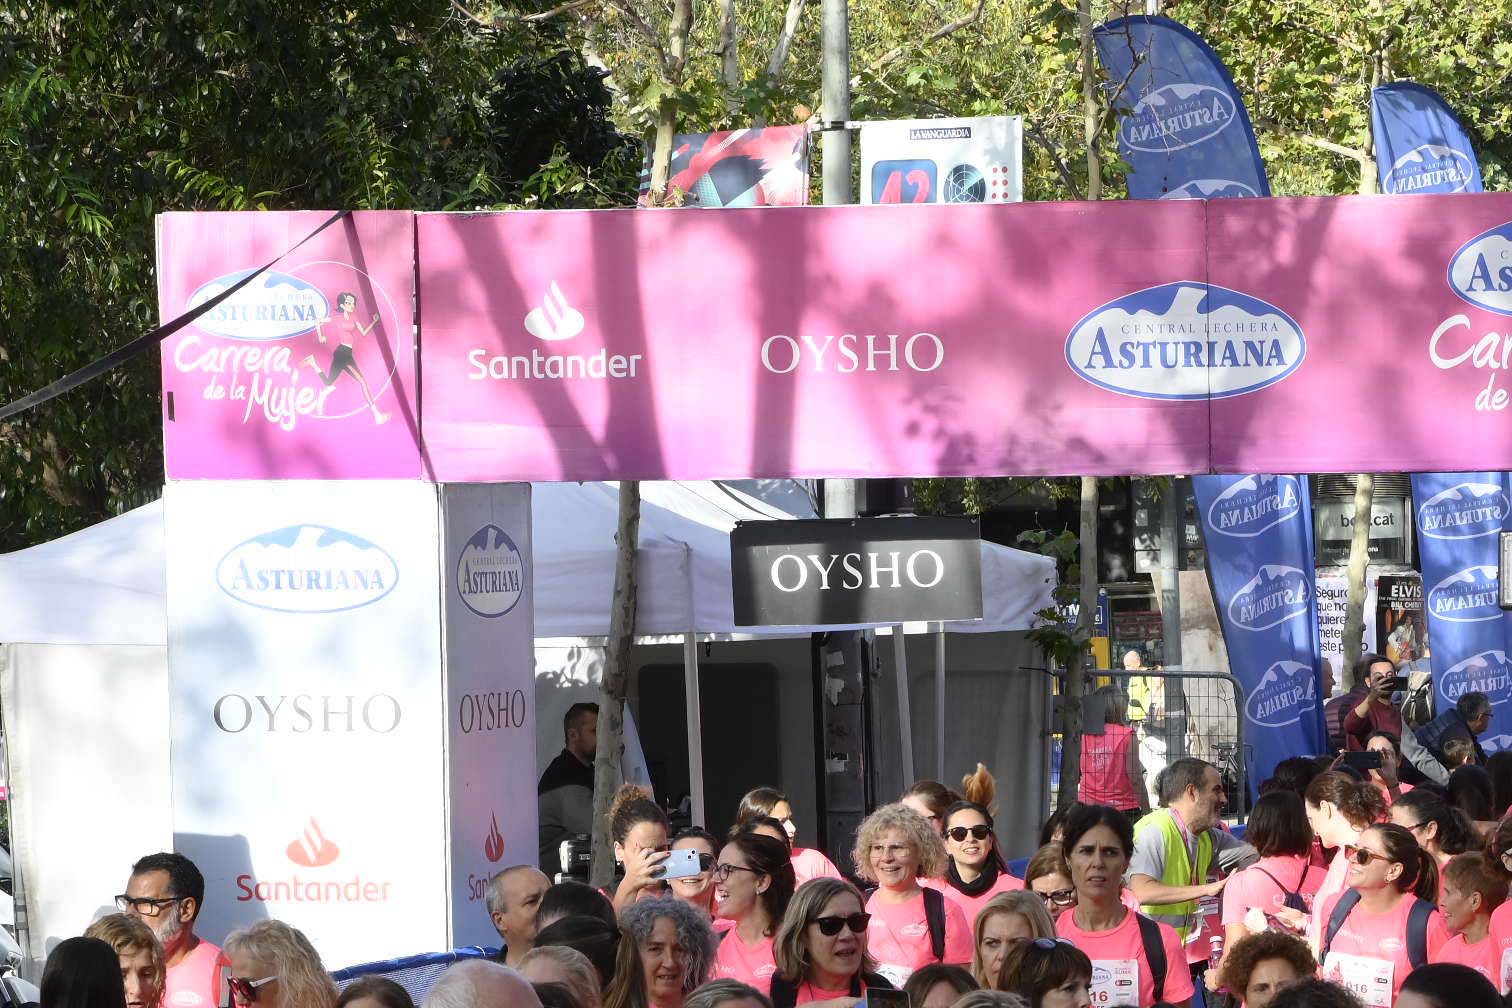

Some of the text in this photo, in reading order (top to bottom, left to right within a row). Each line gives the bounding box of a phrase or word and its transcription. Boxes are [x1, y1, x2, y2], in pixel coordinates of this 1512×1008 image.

[1121, 320, 1279, 336] CENTRAL LECHERA
[174, 335, 292, 374] Carrera
[468, 348, 642, 381] Santander
[760, 331, 945, 374] OYSHO
[1084, 326, 1288, 369] ASTURIANA
[203, 373, 248, 400] de la
[243, 368, 337, 431] Mujer
[1475, 373, 1510, 411] de
[231, 558, 386, 592] ASTURIANA
[462, 561, 520, 595] ASTURIANA
[770, 549, 945, 593] OYSHO
[1391, 585, 1422, 597] ELVIS
[213, 693, 402, 734] OYSHO
[459, 689, 526, 734] OYSHO
[236, 873, 391, 902] Santander
